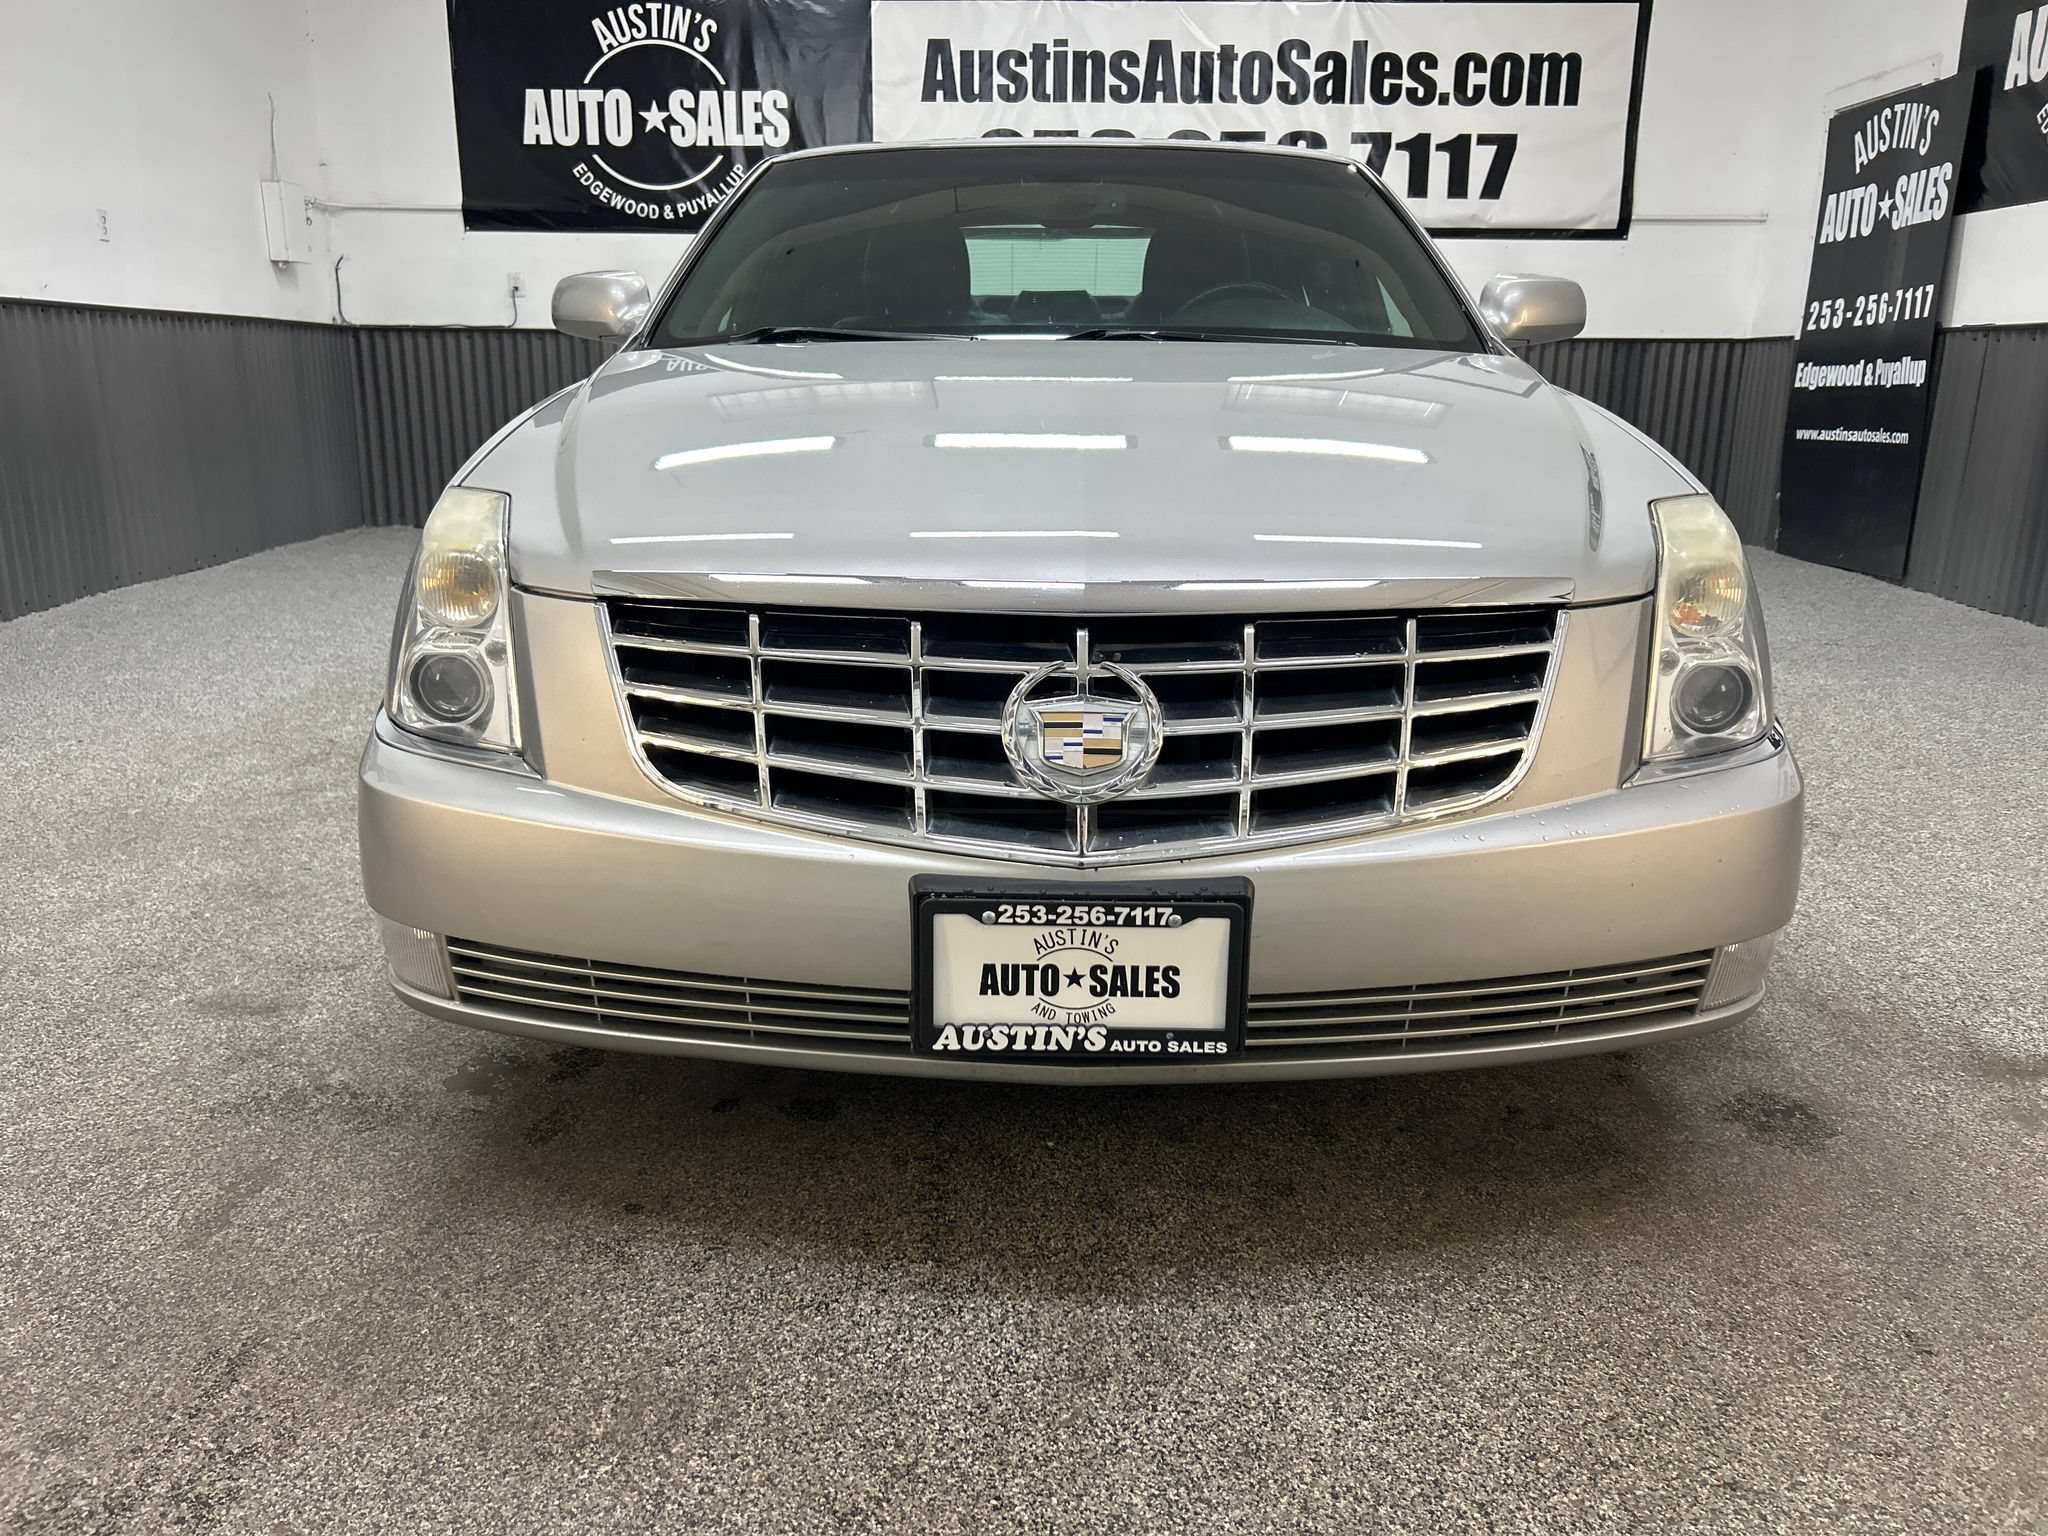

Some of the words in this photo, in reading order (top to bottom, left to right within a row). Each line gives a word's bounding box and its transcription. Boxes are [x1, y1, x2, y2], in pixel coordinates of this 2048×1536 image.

[591, 2, 718, 54] AUSTIN'S
[921, 38, 1583, 107] AustinsAutoSales.com
[522, 88, 633, 147] AUTO
[668, 89, 790, 147] SALES
[1854, 103, 1940, 174] AUSTIN'S
[572, 162, 660, 219] EDGEWOOD
[663, 204, 675, 220] &
[676, 163, 746, 218] PUYALLUP
[1819, 183, 1878, 244] AUTO
[1891, 162, 1953, 230] SALES
[1807, 284, 1934, 331] 253-256-7117
[1794, 359, 1865, 391] Edgewood
[1864, 361, 1874, 387] &
[1874, 356, 1927, 388] Puyallup
[1796, 426, 1909, 445] www.austinsautosales.com
[997, 904, 1173, 926] 253-256-7117
[1033, 928, 1119, 956] AUSTIN'S
[979, 963, 1060, 996] AUTO
[1088, 964, 1181, 998] SALES
[1031, 1002, 1057, 1021] AND
[1066, 1002, 1117, 1025] TOWING
[932, 1024, 1109, 1052] AUSTIN'S
[1109, 1039, 1162, 1053] AUTO
[1167, 1040, 1228, 1053] SALES
